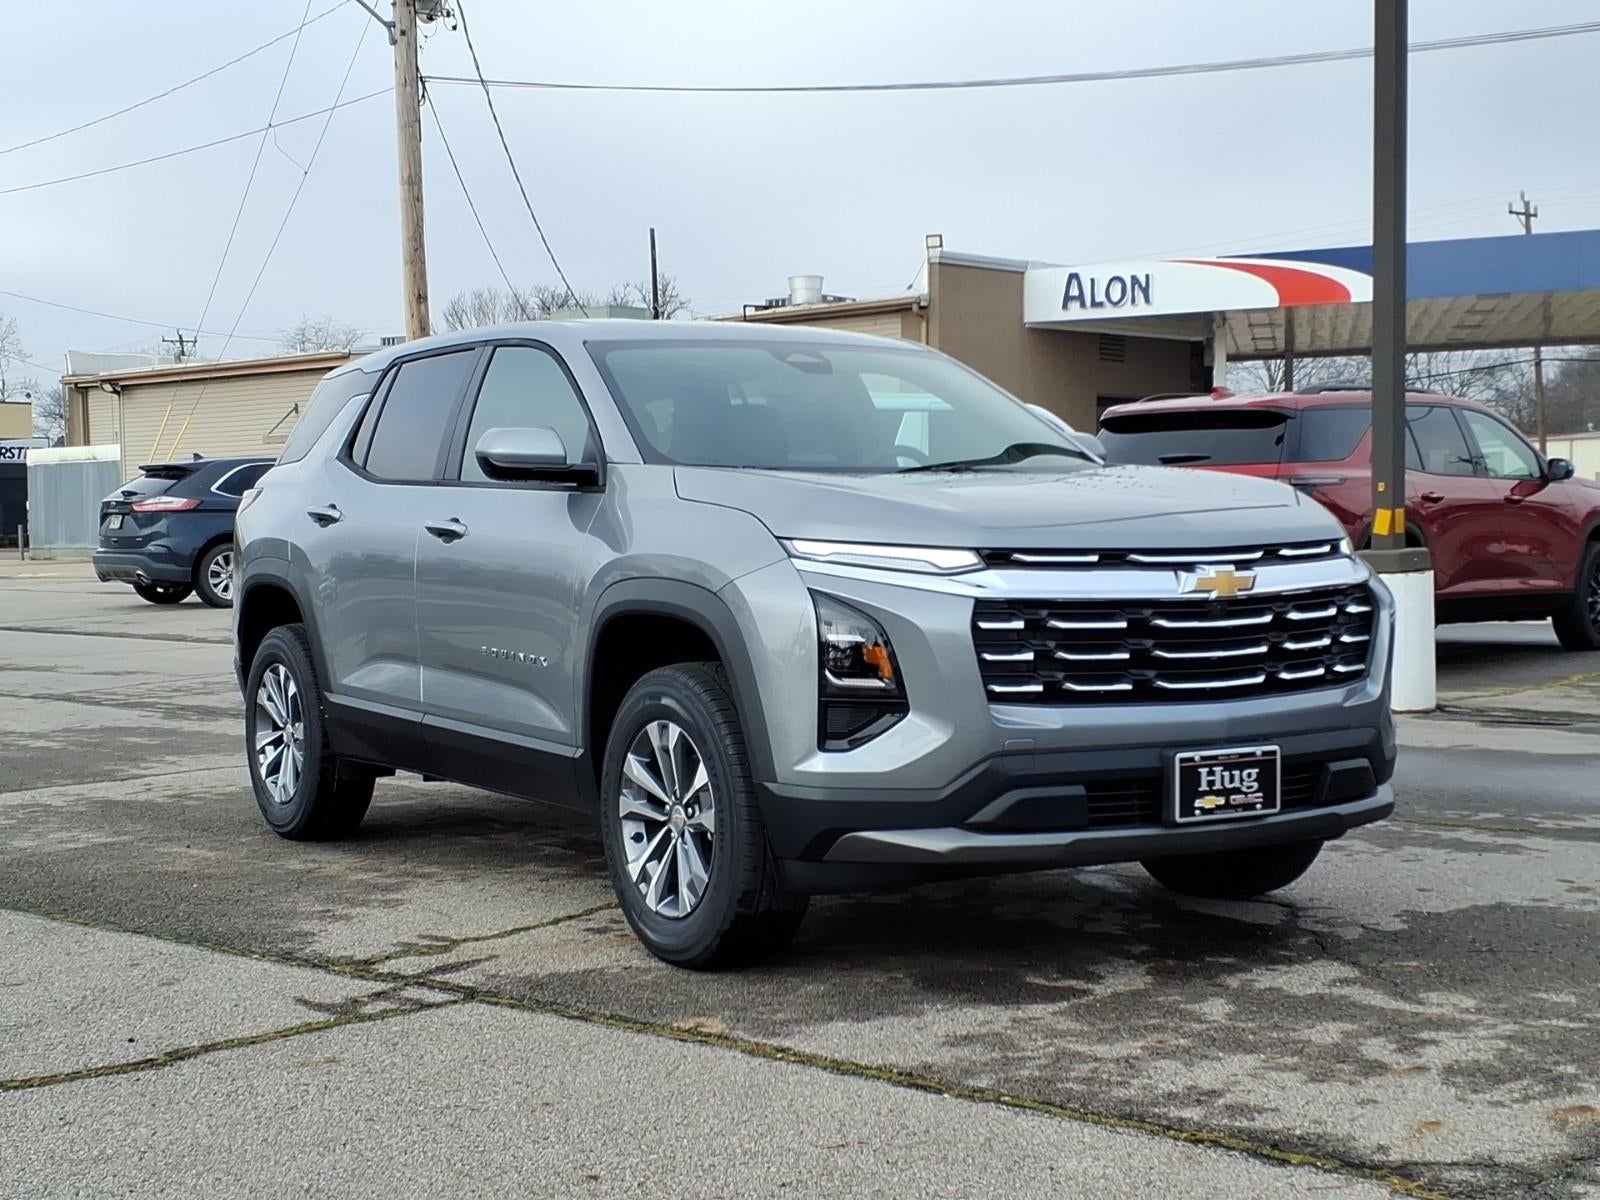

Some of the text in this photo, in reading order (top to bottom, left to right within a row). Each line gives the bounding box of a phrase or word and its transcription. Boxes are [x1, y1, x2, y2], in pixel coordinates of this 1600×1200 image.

[1061, 272, 1151, 310] ALON
[0, 446, 29, 460] RST
[481, 645, 548, 667] EQUINOX
[1197, 766, 1260, 792] Hug
